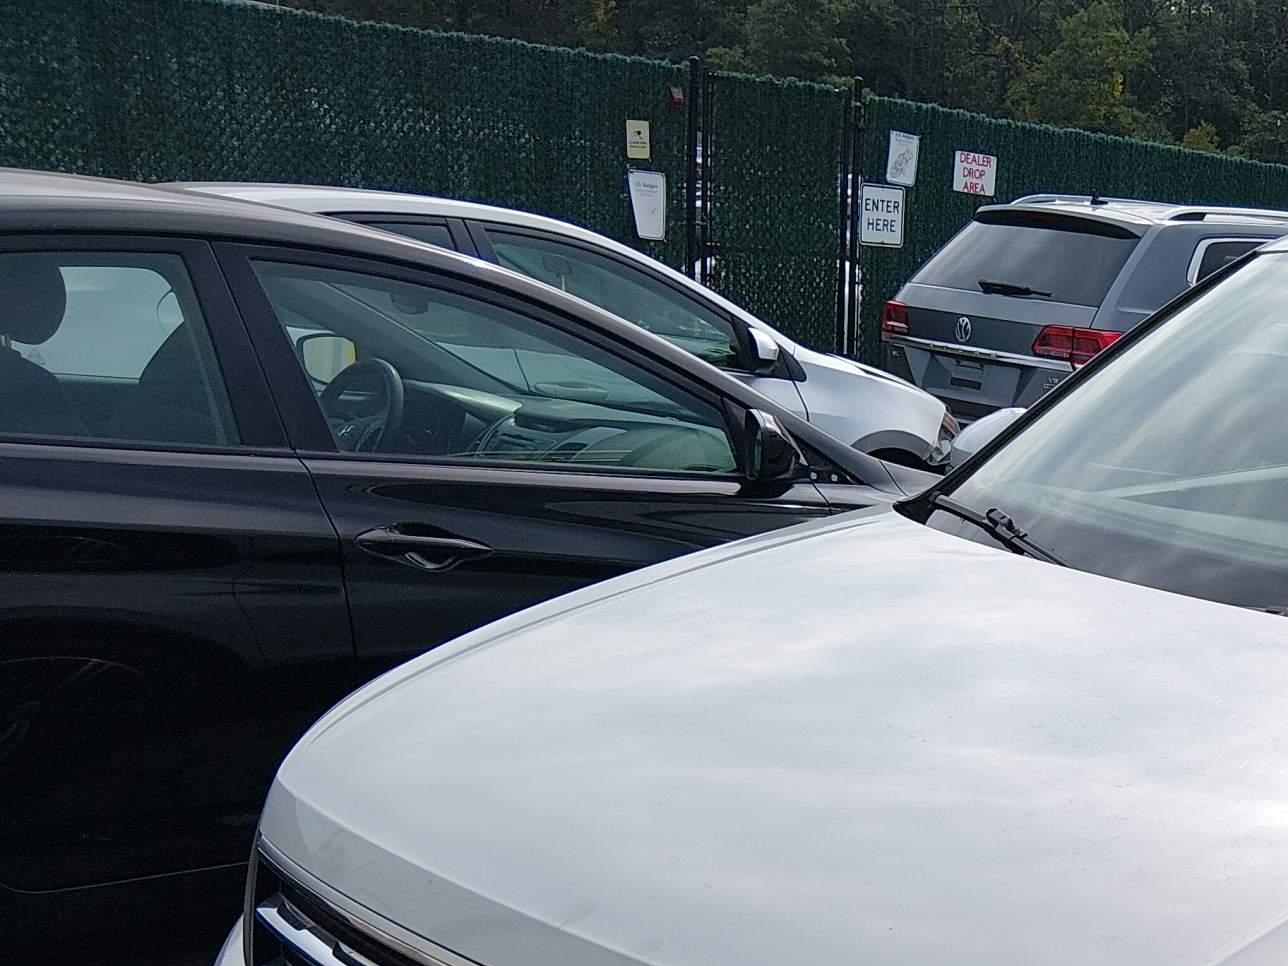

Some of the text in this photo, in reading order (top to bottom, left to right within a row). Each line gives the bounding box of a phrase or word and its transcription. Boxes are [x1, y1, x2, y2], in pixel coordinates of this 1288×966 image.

[960, 152, 992, 168] DEALER
[963, 167, 986, 180] DROP
[963, 181, 986, 195] AREA
[864, 198, 900, 214] ENTER
[867, 217, 897, 233] HERE
